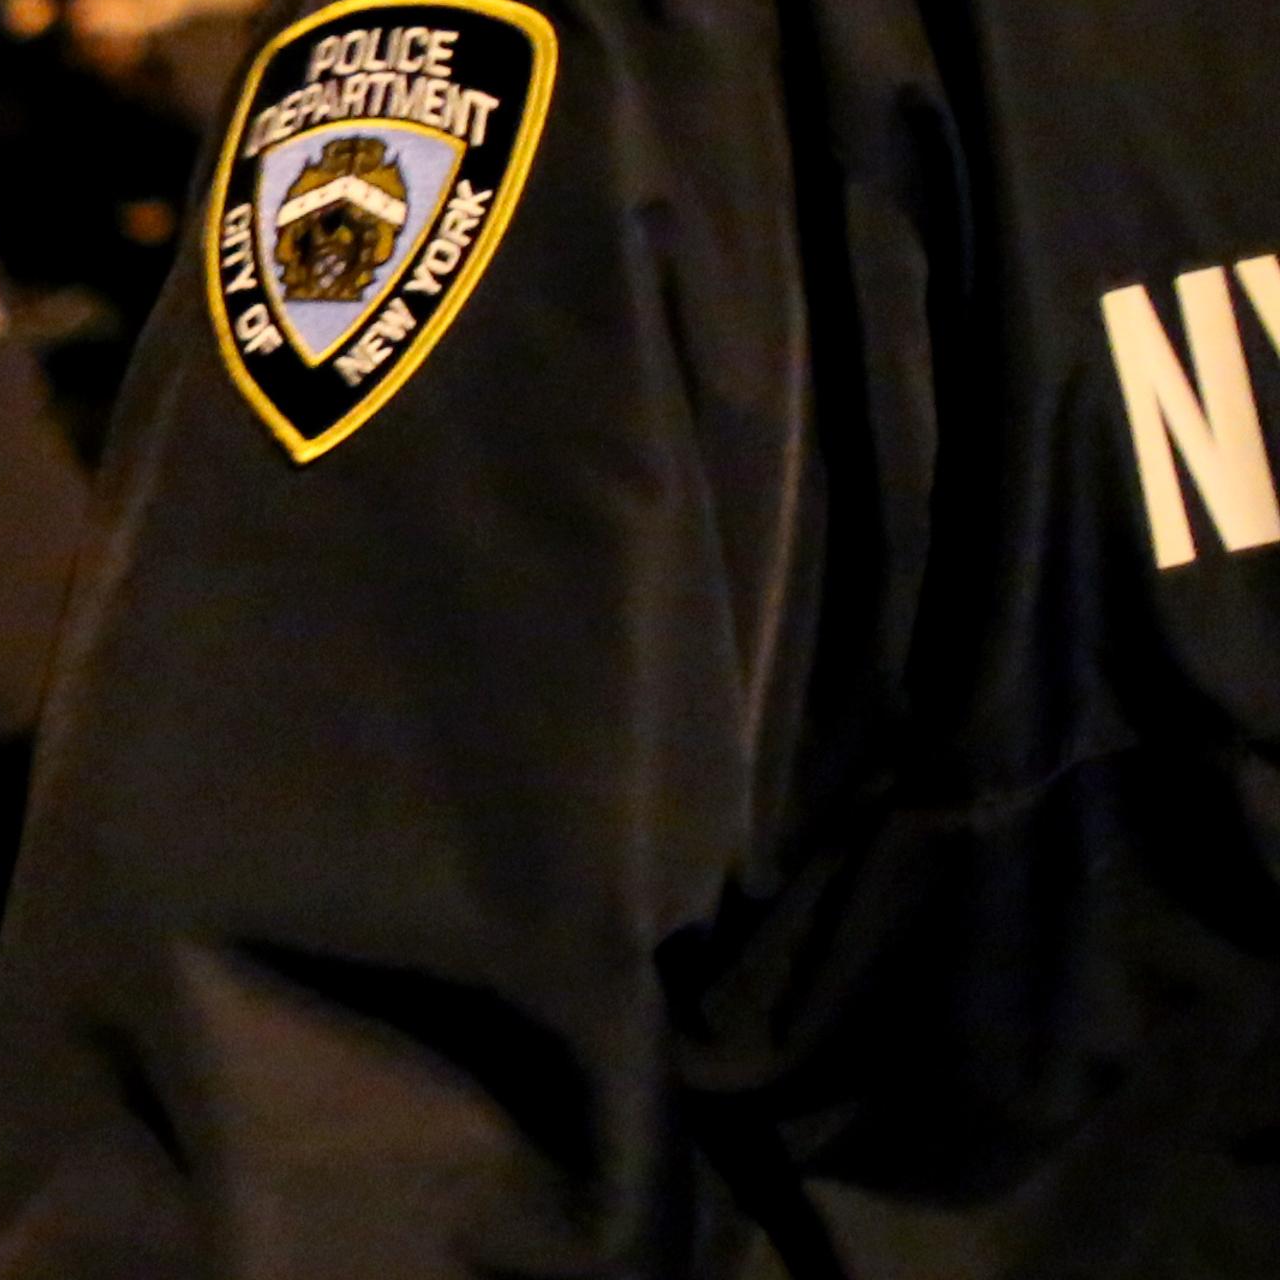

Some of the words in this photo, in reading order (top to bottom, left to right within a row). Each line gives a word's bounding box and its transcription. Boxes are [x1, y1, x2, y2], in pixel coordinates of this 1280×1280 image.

[306, 26, 460, 83] POLICE
[243, 71, 501, 158] DEPARTMENT
[222, 202, 258, 294] CITY
[333, 297, 417, 387] NEW
[402, 179, 493, 296] YORK
[235, 303, 284, 355] OF
